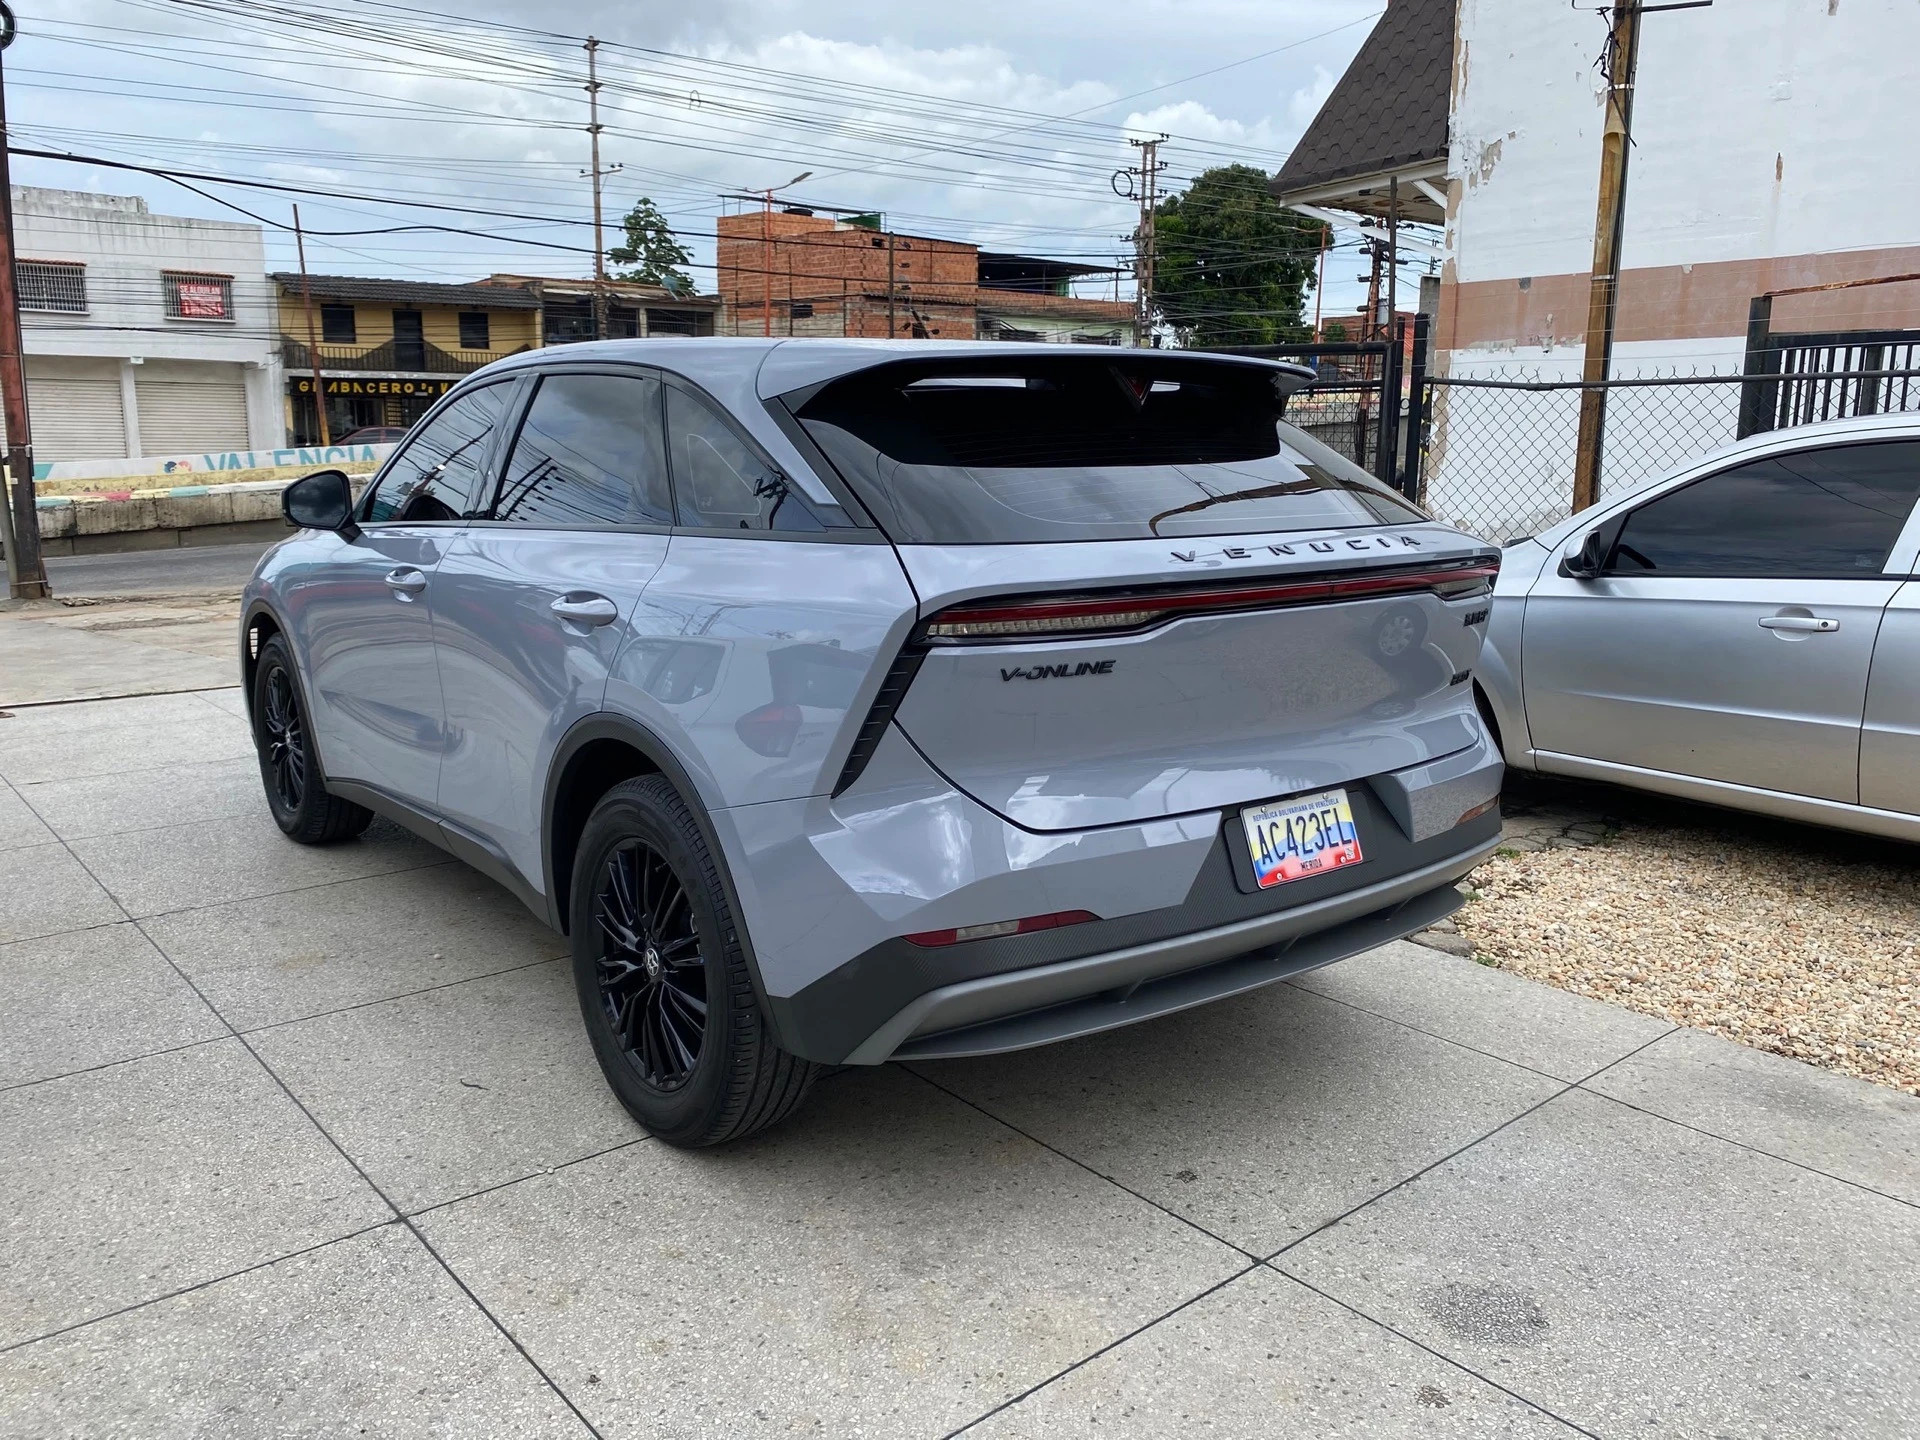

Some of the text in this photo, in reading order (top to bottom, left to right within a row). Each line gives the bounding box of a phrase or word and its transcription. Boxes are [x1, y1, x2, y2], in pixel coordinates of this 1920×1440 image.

[179, 285, 189, 294] SE
[1170, 535, 1421, 562] VENUCIA
[1000, 659, 1117, 682] V-ONLINE
[1279, 805, 1308, 817] BOLIVARIANA
[1308, 803, 1315, 811] DE
[1316, 798, 1339, 809] VENEZUELA
[1257, 807, 1352, 865] AC423EL
[1300, 858, 1323, 872] MERIDA
